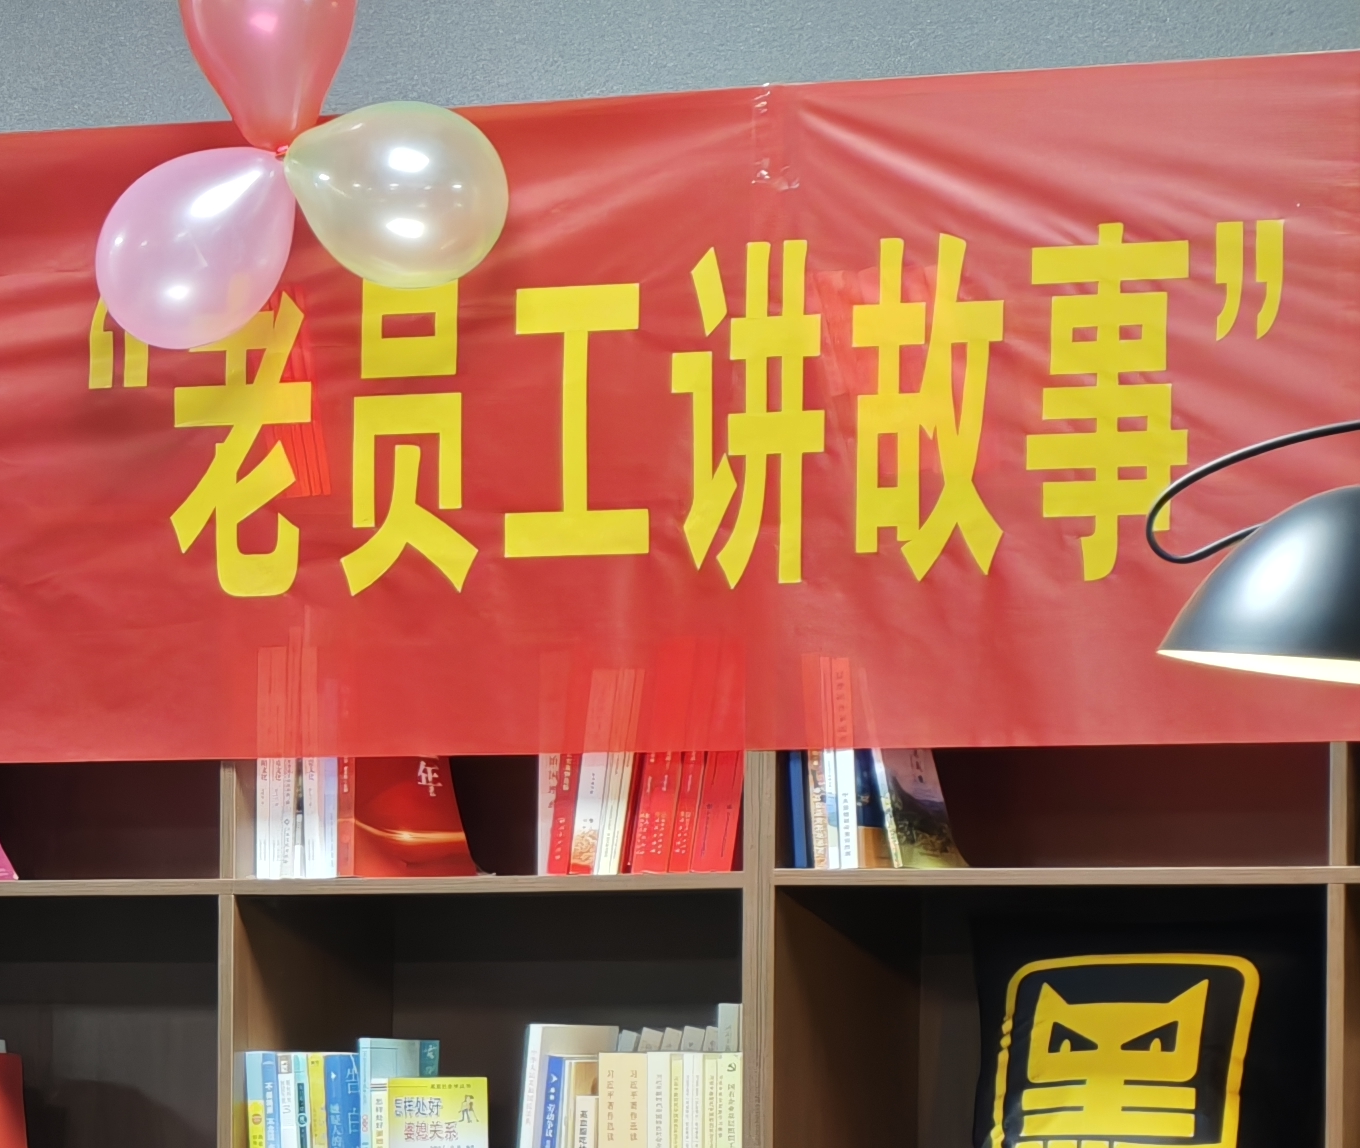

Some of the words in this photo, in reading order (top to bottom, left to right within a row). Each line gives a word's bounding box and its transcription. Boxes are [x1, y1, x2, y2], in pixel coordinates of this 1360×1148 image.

[394, 1097, 443, 1117] 怎样处好
[403, 1120, 459, 1141] 婆媳关系
